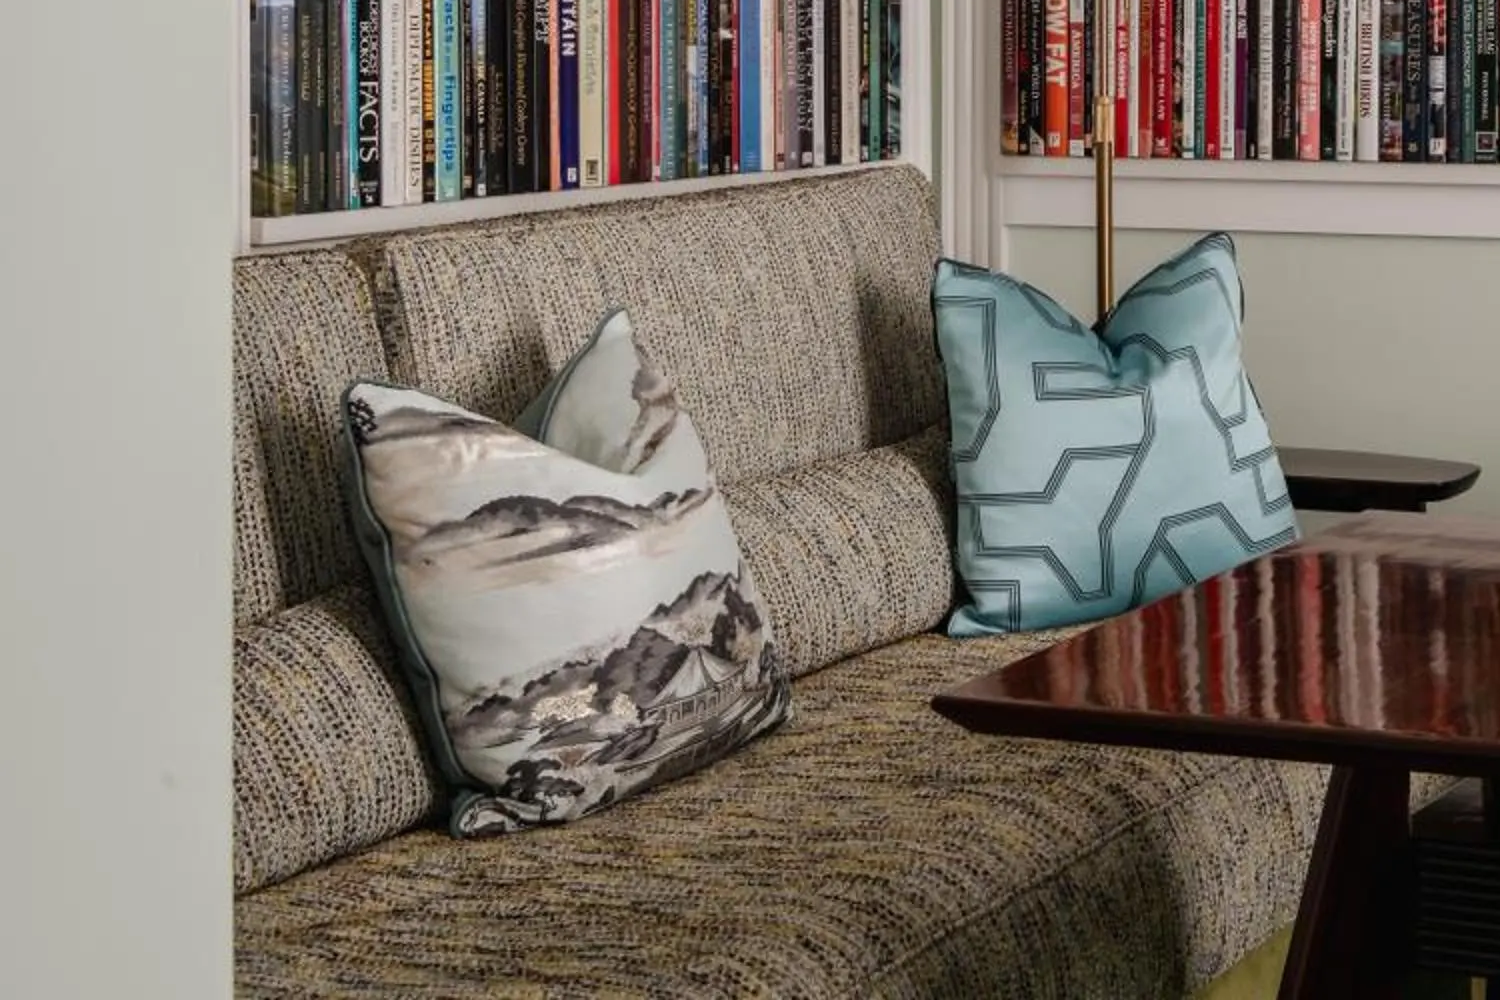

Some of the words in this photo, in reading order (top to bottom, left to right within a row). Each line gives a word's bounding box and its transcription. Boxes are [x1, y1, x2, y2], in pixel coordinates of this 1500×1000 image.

[359, 21, 369, 48] BOOK
[1071, 29, 1082, 89] AMERICA
[1361, 23, 1373, 76] BRITISH
[1046, 43, 1067, 88] FAT
[360, 81, 379, 163] FACTS
[1361, 78, 1373, 119] BIRDS
